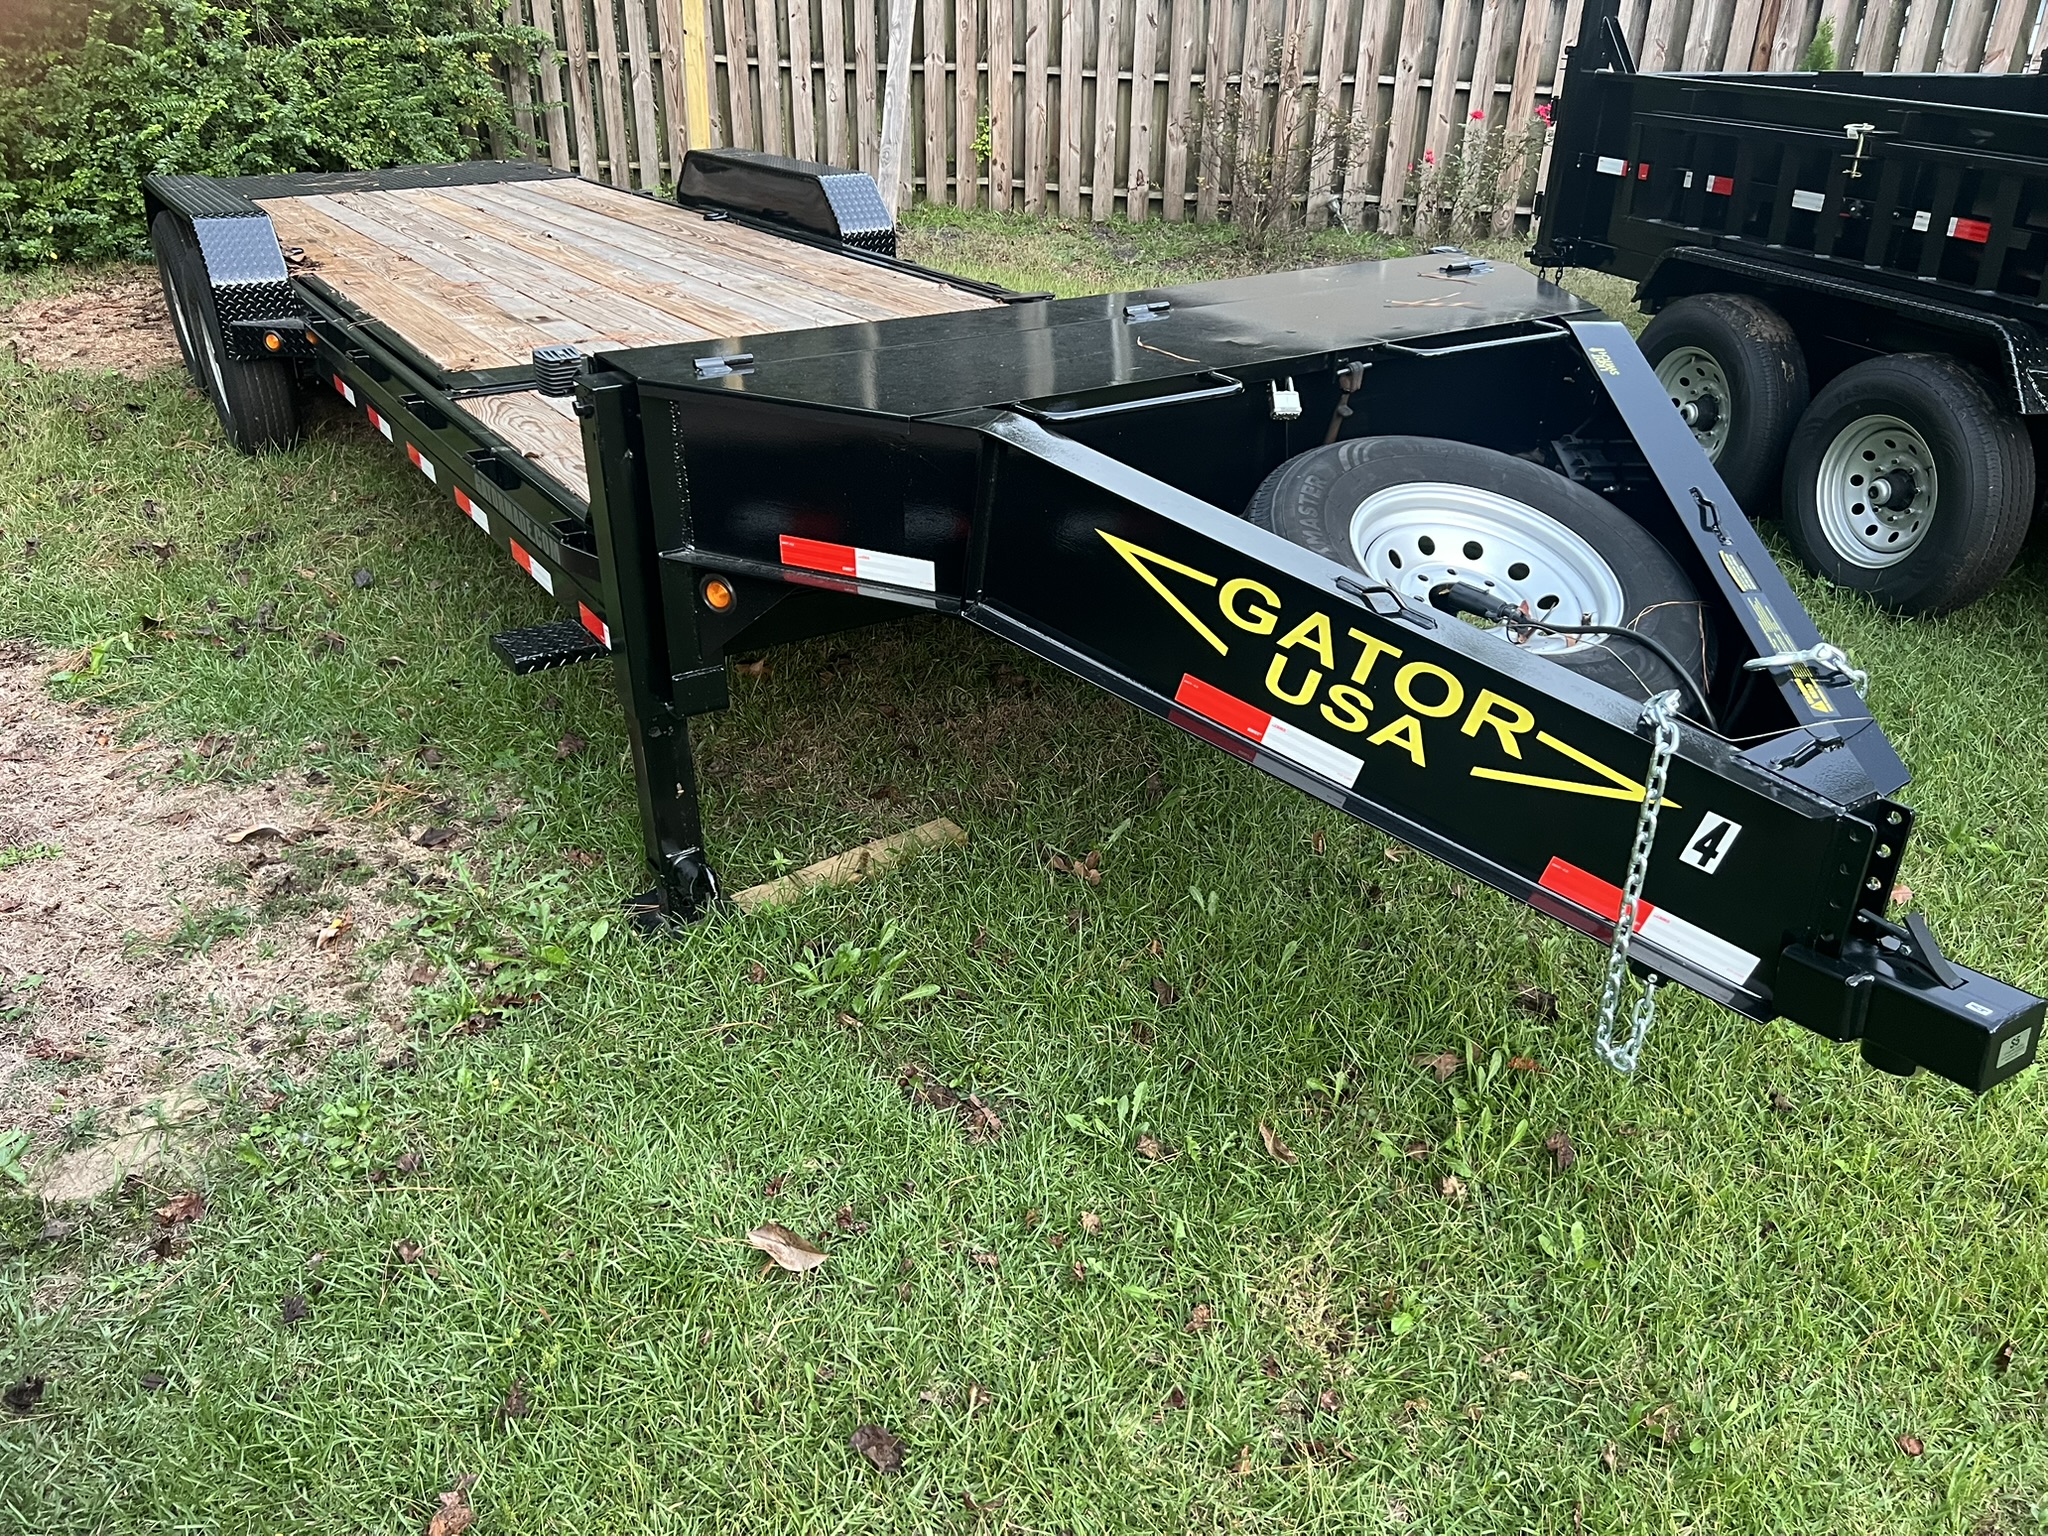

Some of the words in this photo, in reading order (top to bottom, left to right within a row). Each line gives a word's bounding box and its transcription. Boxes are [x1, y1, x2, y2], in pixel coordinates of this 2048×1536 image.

[1218, 577, 1535, 759] GATOR
[1265, 652, 1426, 768] USA
[1692, 820, 1731, 868] 4
